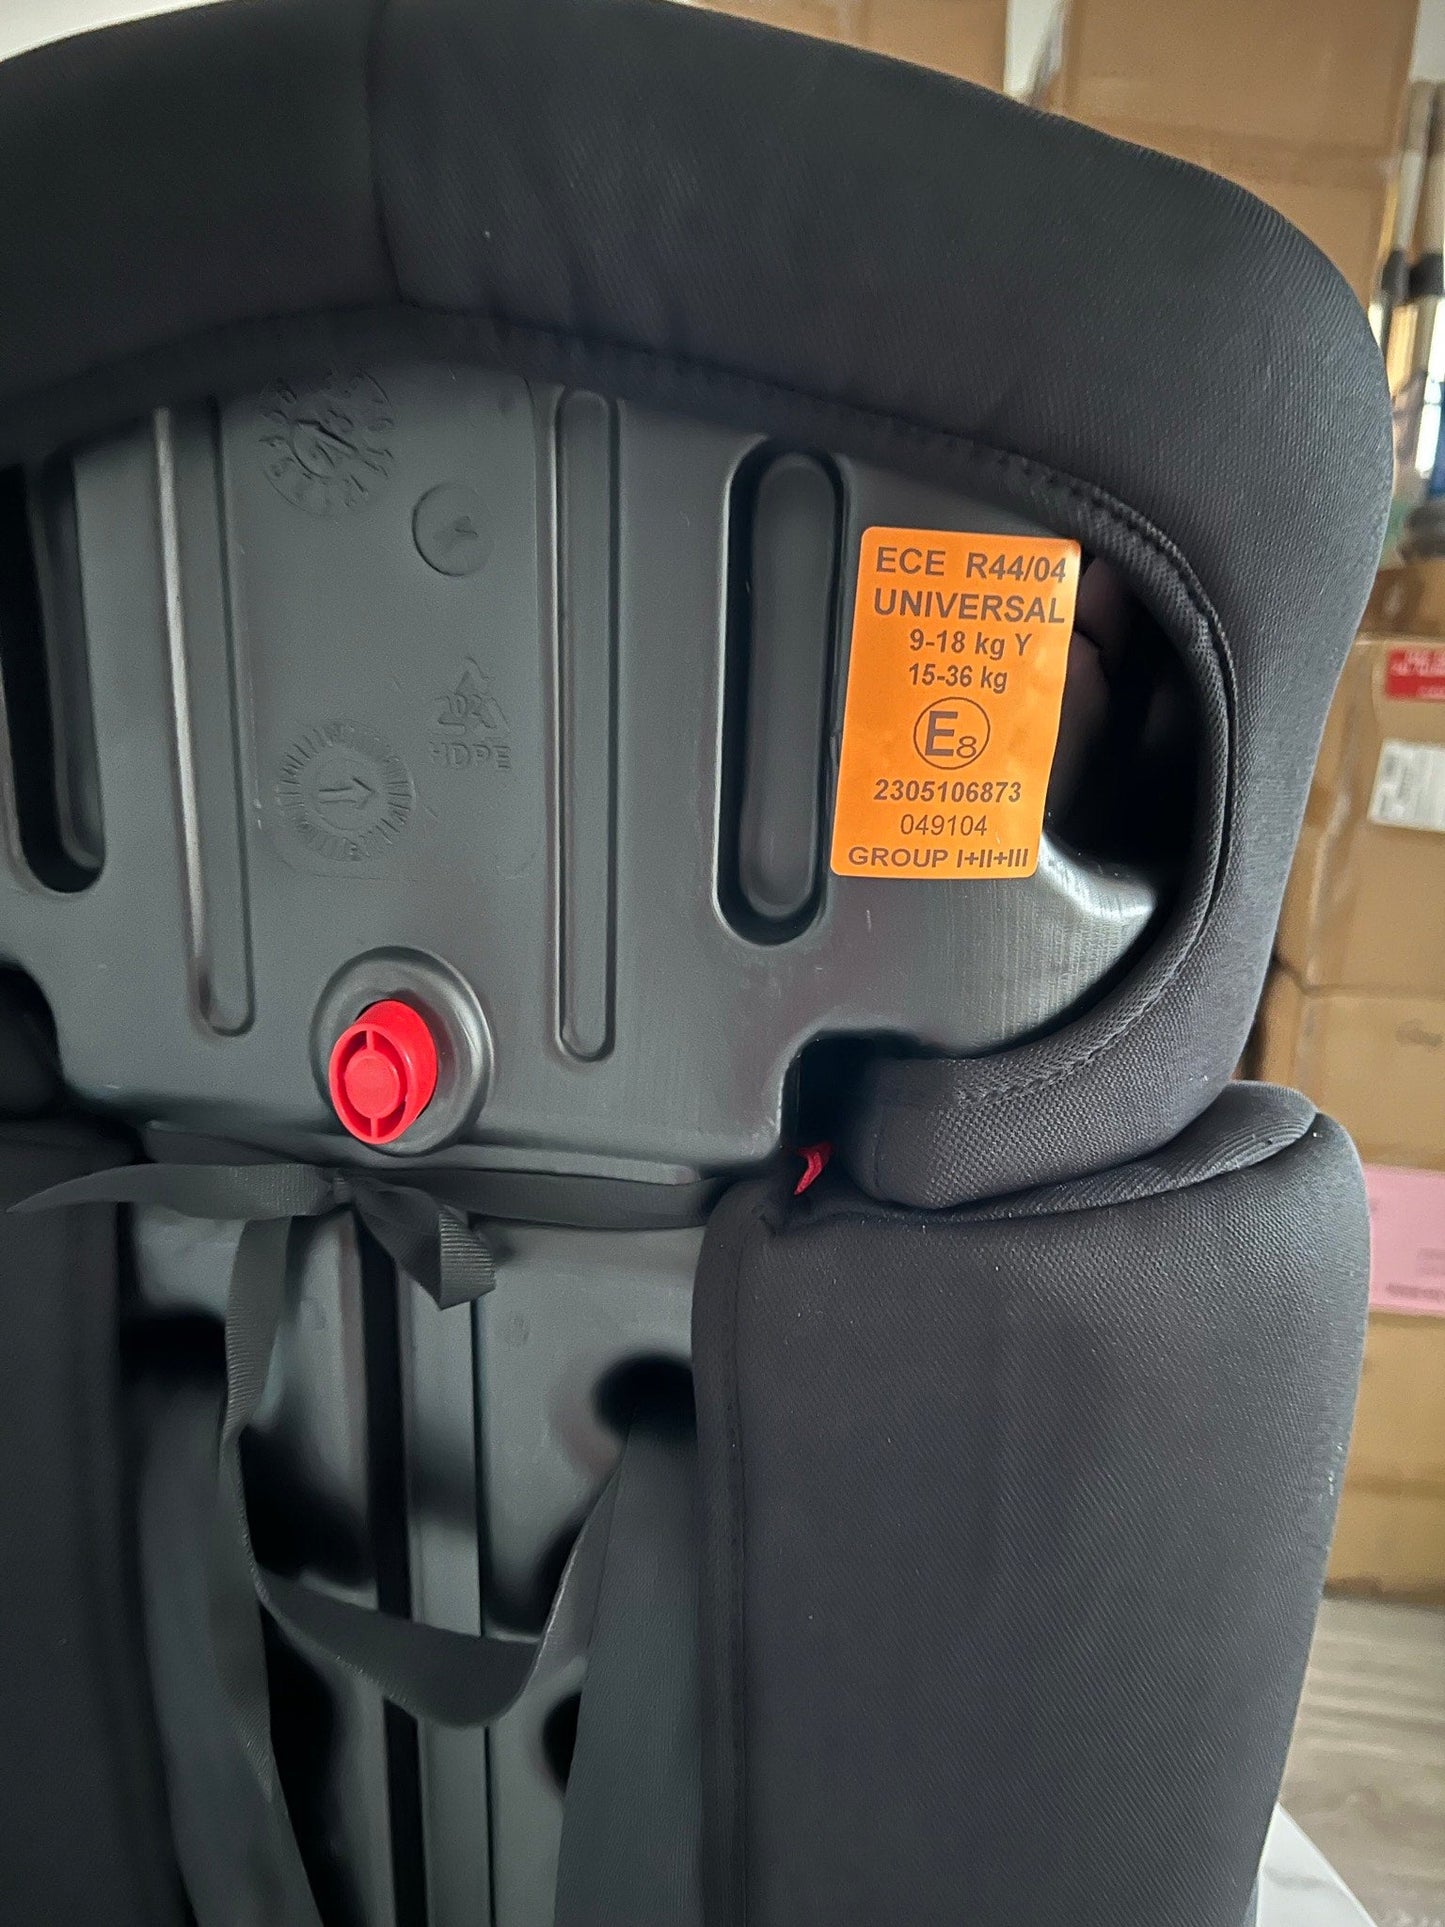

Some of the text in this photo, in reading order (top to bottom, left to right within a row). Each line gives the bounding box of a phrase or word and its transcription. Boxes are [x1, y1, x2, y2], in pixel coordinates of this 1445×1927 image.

[876, 547, 1066, 583] ECE R44/04
[874, 588, 1065, 623] UNIVERSAL
[910, 629, 1032, 660] 9-18 kg Y
[909, 663, 1007, 693] 15-36 kg
[874, 779, 1021, 802] 2305106873
[901, 814, 987, 836] 049104
[849, 847, 1028, 868] GROUP I+II+III
